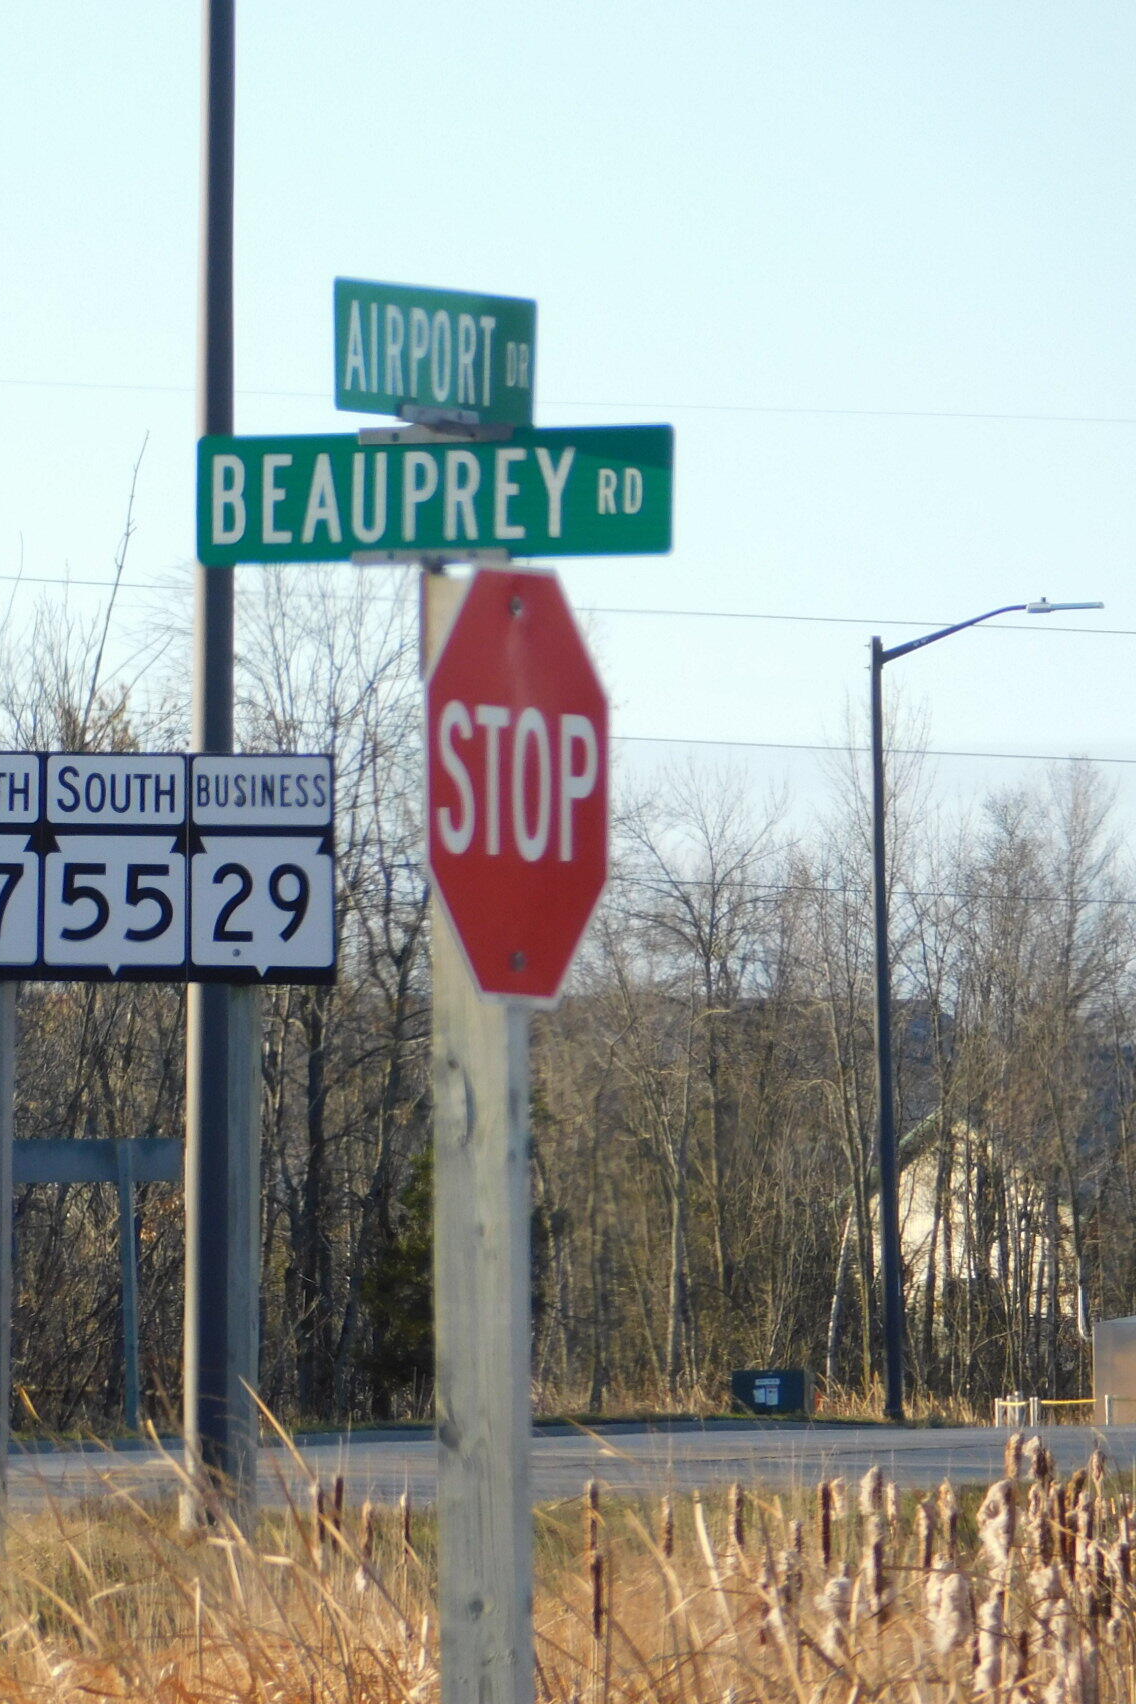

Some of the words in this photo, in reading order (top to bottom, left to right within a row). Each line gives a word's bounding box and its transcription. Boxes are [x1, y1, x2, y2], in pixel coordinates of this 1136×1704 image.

[344, 299, 496, 407] AIRPORT
[505, 341, 530, 389] DR
[210, 446, 576, 546] BEAUPREY
[596, 467, 643, 514] RD
[57, 765, 176, 814] SOUTH
[196, 773, 327, 808] BUSINESS
[437, 699, 599, 863] STOP
[60, 863, 174, 942] 55
[211, 862, 310, 943] 29
